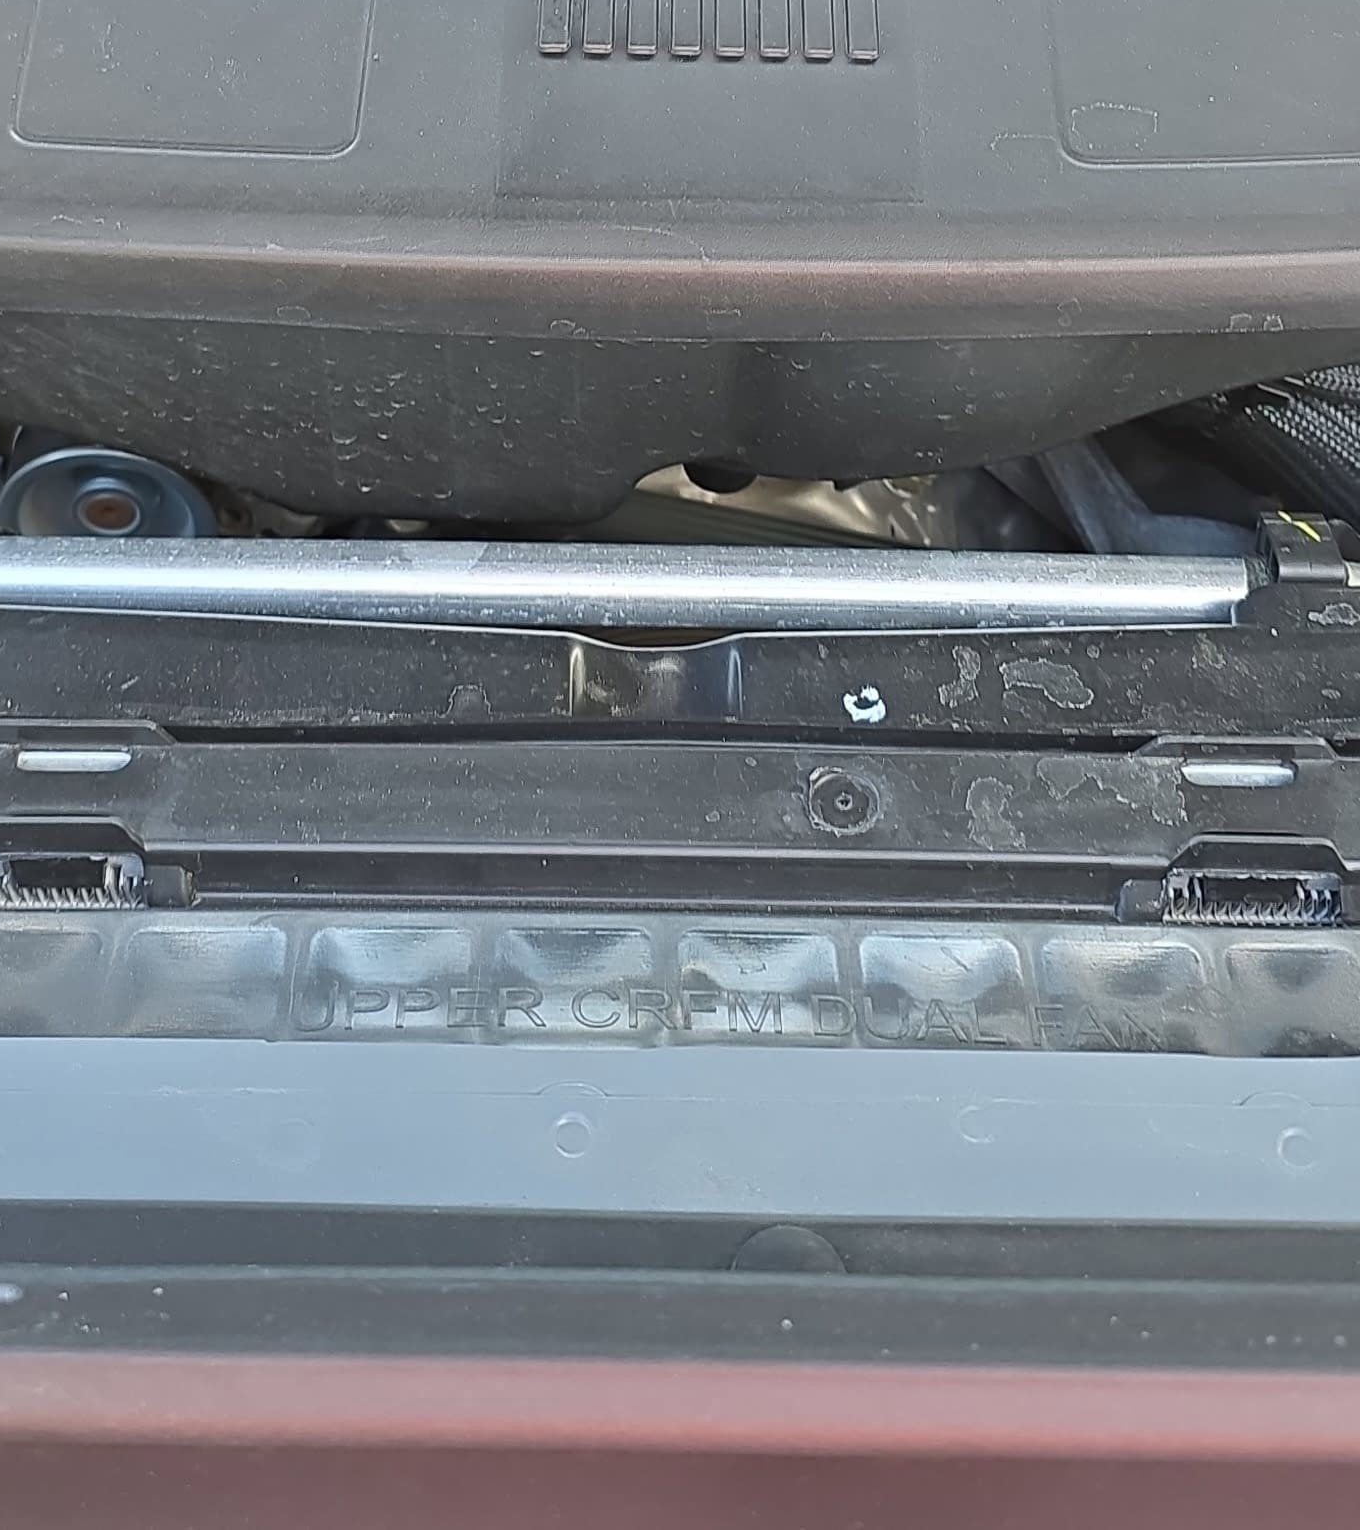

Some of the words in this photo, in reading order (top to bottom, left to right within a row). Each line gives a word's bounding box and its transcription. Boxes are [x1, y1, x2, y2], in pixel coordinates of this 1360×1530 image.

[290, 987, 547, 1032] UPPER
[571, 987, 783, 1035] CRFM
[811, 993, 1008, 1045] DUAL
[1031, 1002, 1166, 1051] FAN
